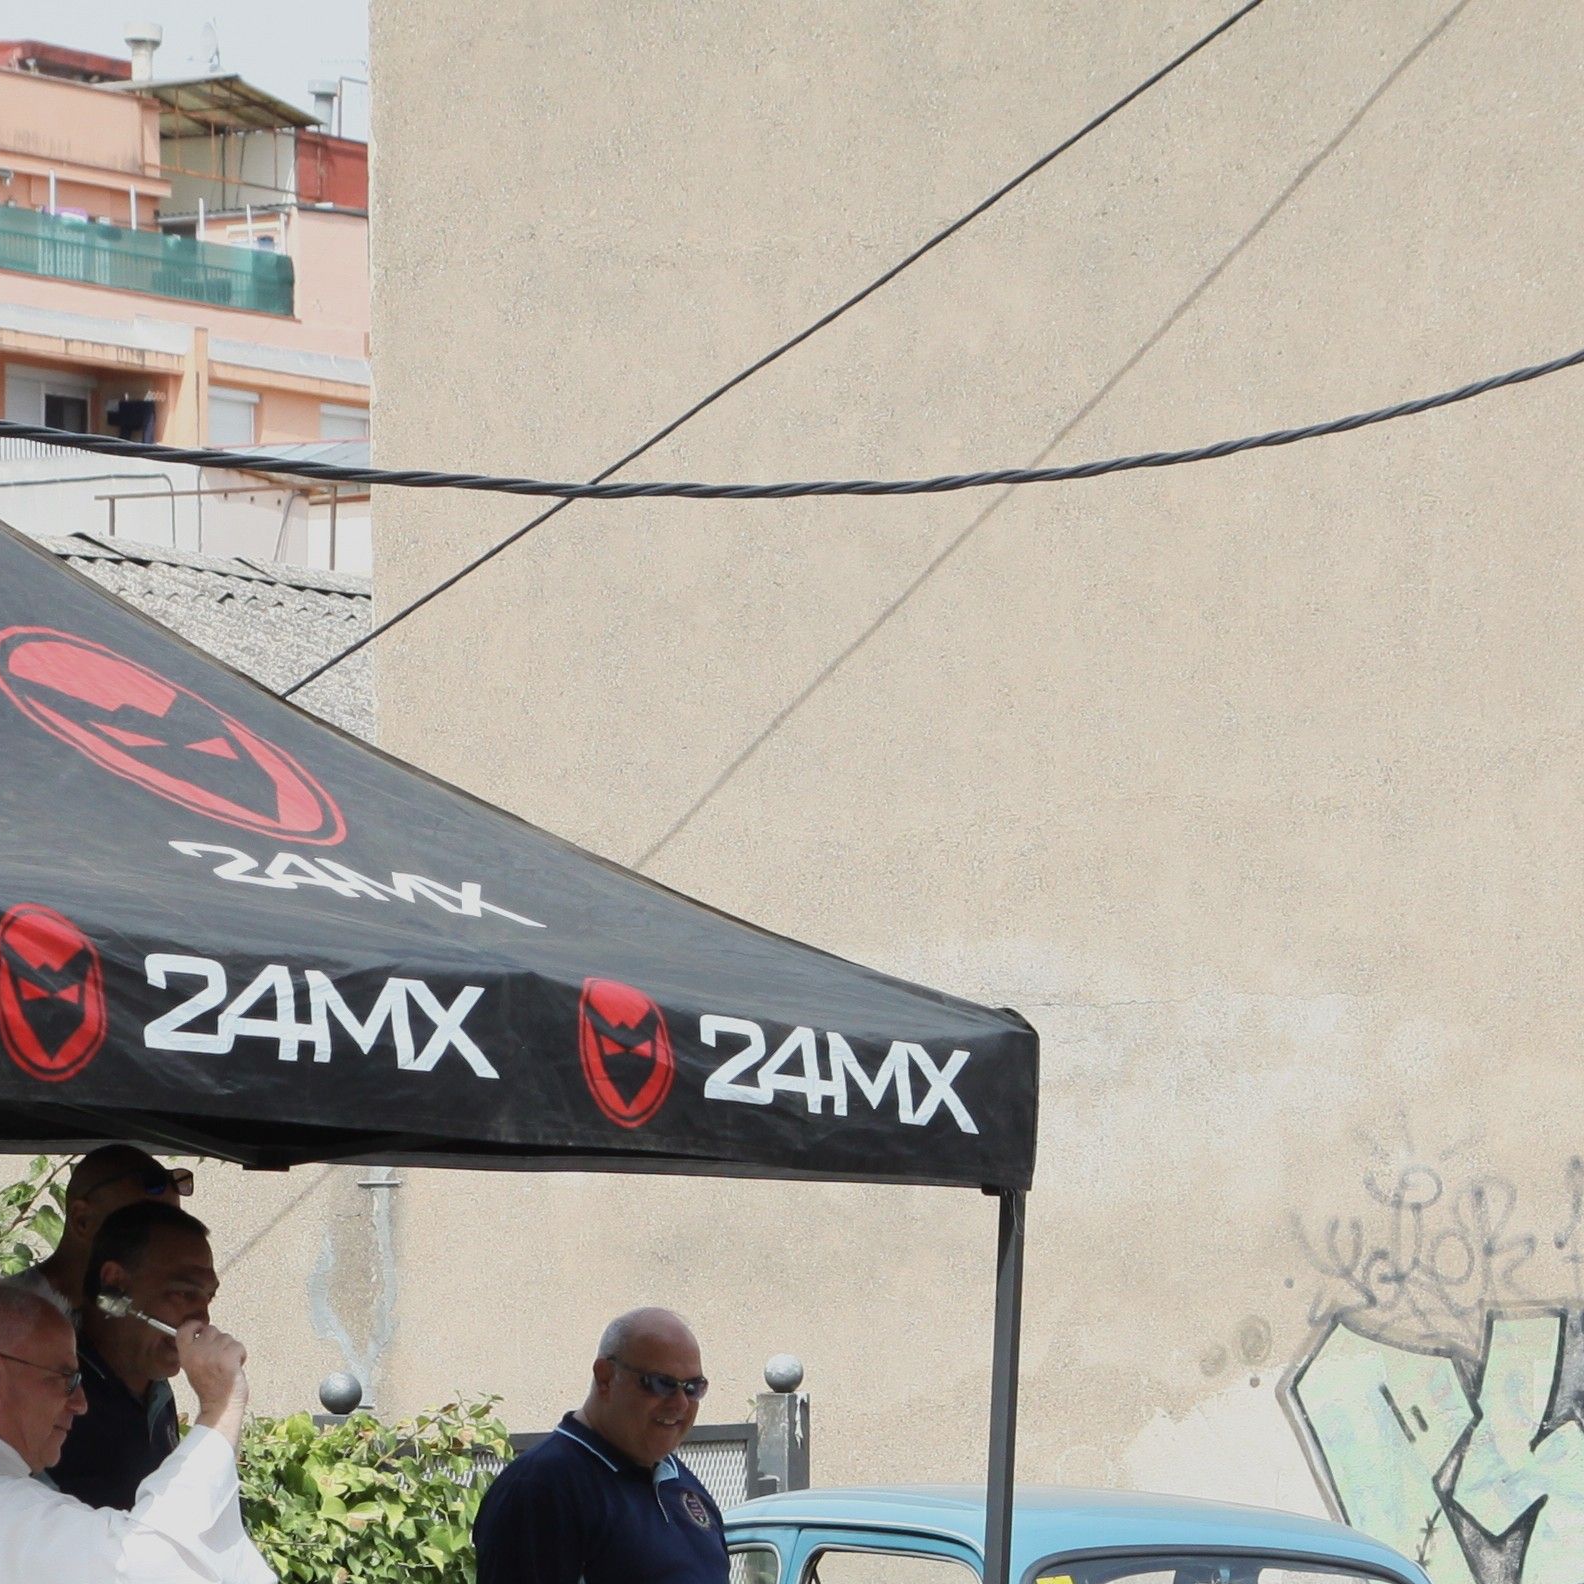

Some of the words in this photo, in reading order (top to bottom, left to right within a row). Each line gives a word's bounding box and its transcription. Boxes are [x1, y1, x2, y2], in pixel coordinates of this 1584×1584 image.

[168, 840, 546, 928] 24MX
[144, 953, 499, 1080] 24MX
[699, 1014, 980, 1134] 24MX
